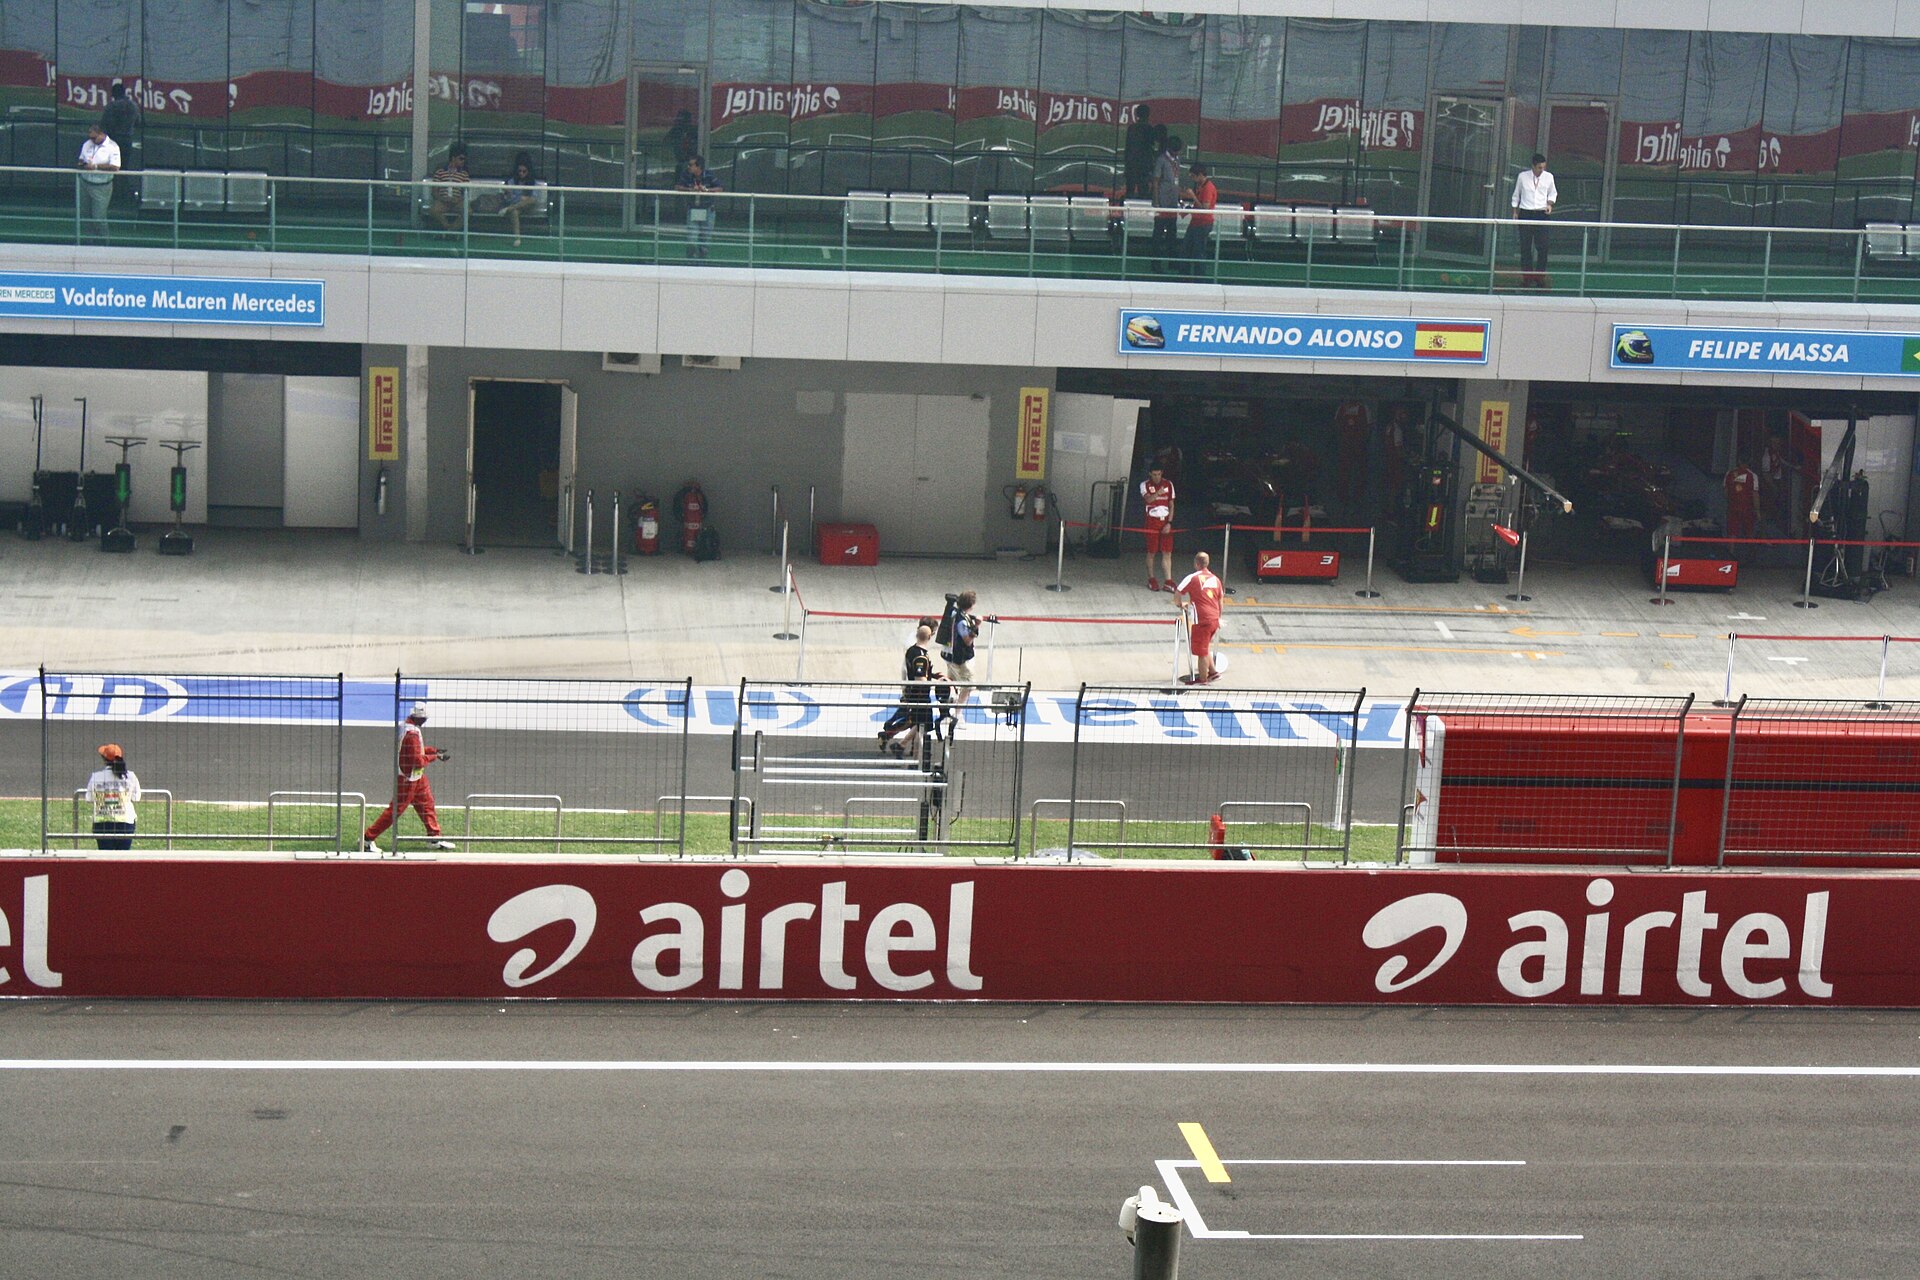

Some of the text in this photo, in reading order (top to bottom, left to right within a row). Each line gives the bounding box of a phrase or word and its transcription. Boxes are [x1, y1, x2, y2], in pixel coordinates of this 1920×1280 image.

[15, 289, 55, 299] MERCEDES
[61, 287, 316, 313] Vodafone McLaren Mercedes
[1177, 324, 1403, 349] FERNANDO ALONSO
[1688, 340, 1849, 363] FELIPE MASSA
[374, 375, 393, 452] PIRELLI
[1021, 395, 1043, 472] PIRELLI
[844, 545, 858, 555] 4
[1320, 555, 1334, 565] 3
[1718, 564, 1732, 574] 4
[631, 868, 984, 992] airtel
[1497, 878, 1833, 998] airtel
